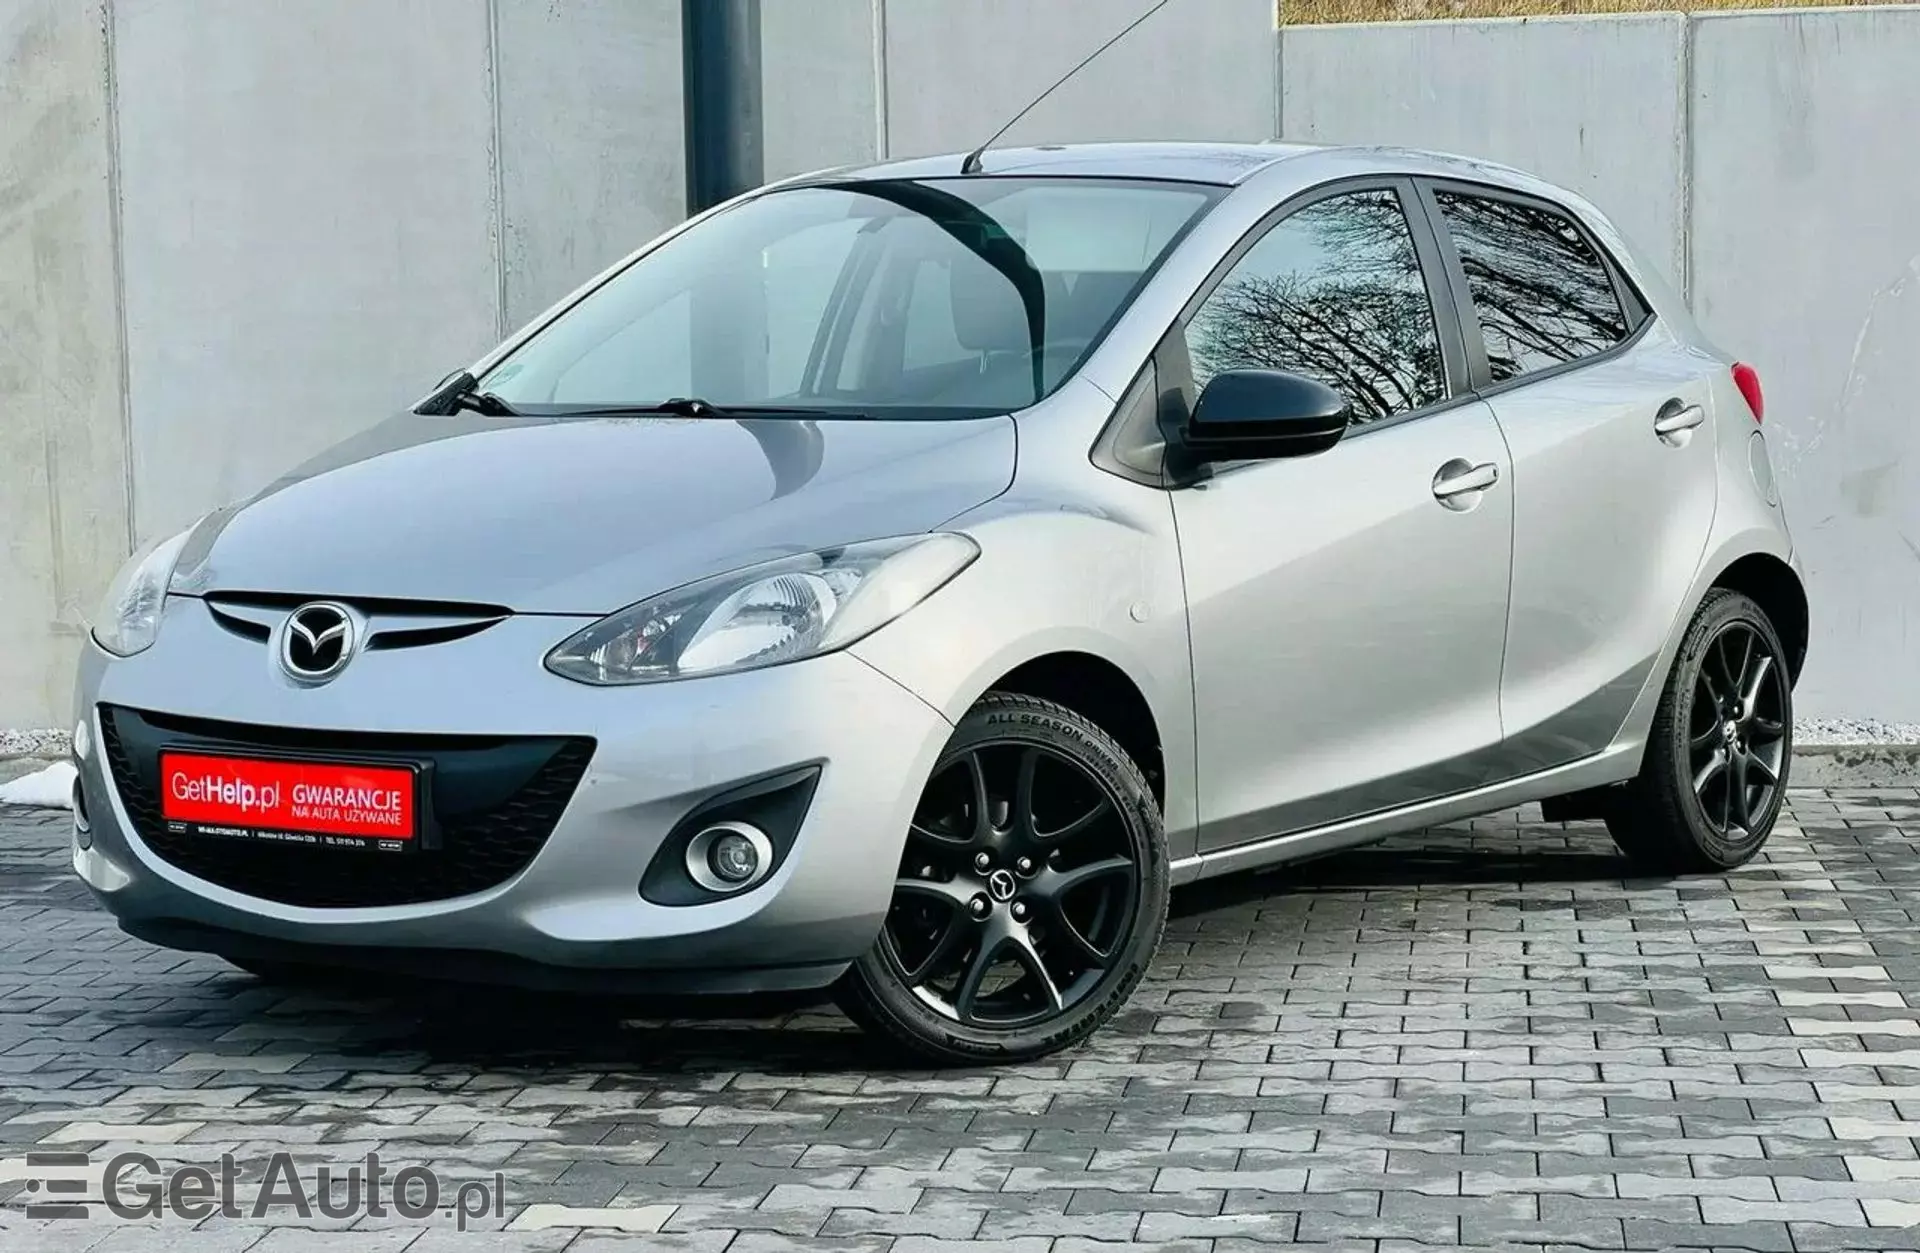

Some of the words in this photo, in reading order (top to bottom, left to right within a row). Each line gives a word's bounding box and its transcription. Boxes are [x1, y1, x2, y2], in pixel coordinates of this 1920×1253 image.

[987, 713, 1015, 725] ALL
[1020, 714, 1083, 742] SEASON
[172, 772, 279, 812] GetHelp.pl
[292, 784, 402, 811] GWARANCJE
[291, 805, 309, 819] NA
[312, 807, 341, 822] AUTA
